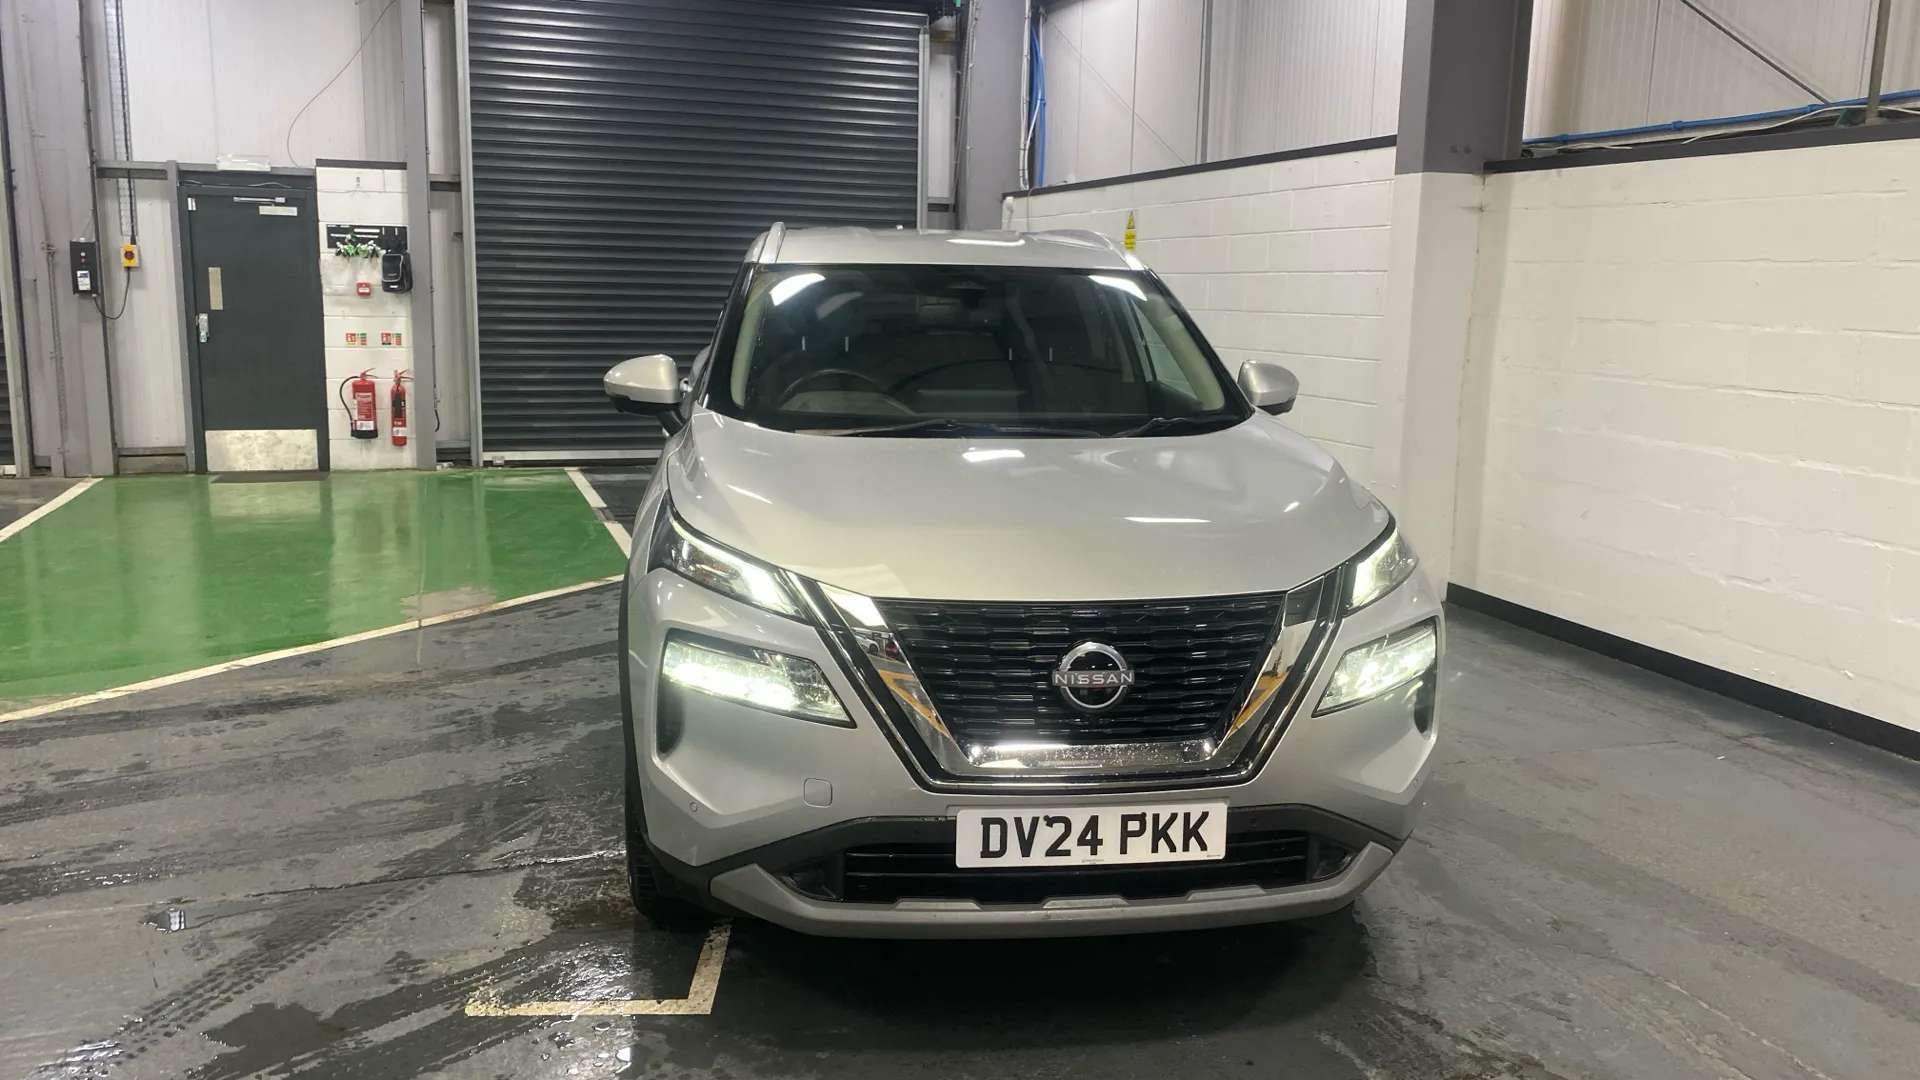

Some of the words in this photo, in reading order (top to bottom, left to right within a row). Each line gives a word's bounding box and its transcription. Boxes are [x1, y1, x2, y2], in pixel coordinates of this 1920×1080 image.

[1055, 673, 1133, 685] NISSAN
[980, 815, 1103, 858] DV24
[1120, 811, 1209, 855] PKK
